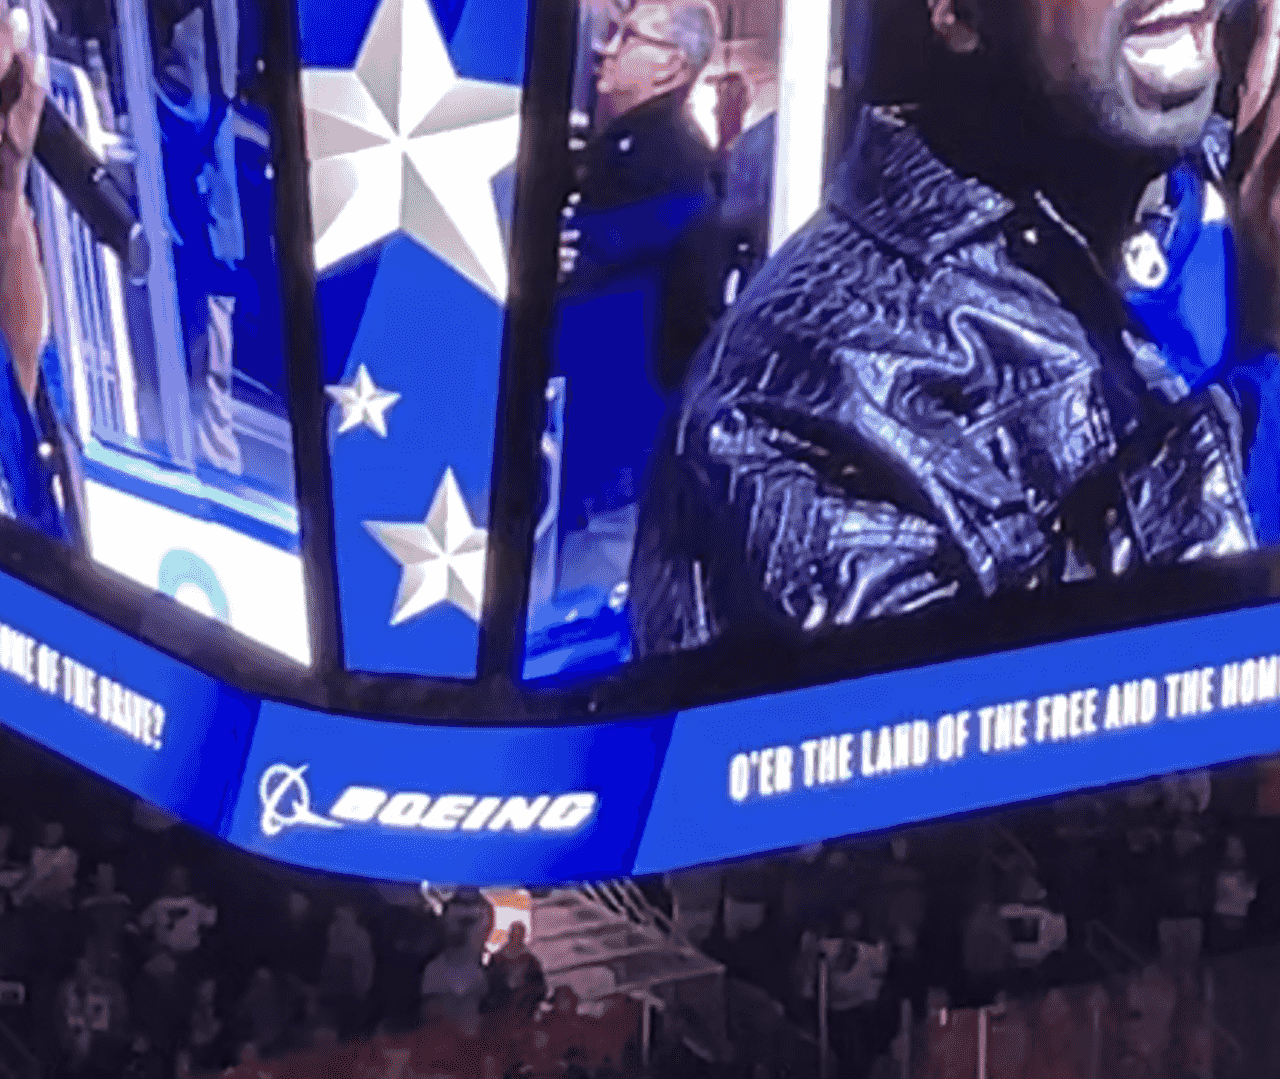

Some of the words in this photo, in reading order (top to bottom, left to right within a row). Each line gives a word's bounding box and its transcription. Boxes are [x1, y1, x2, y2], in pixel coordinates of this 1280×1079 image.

[729, 745, 794, 802] O'ER
[800, 732, 853, 788] THE
[861, 719, 930, 777] LAND
[936, 710, 970, 762] OF
[977, 699, 1029, 754] THE
[1035, 687, 1099, 743] FREE
[1104, 678, 1156, 730] AND
[1164, 666, 1215, 719] THE
[330, 786, 598, 831] BOEING
